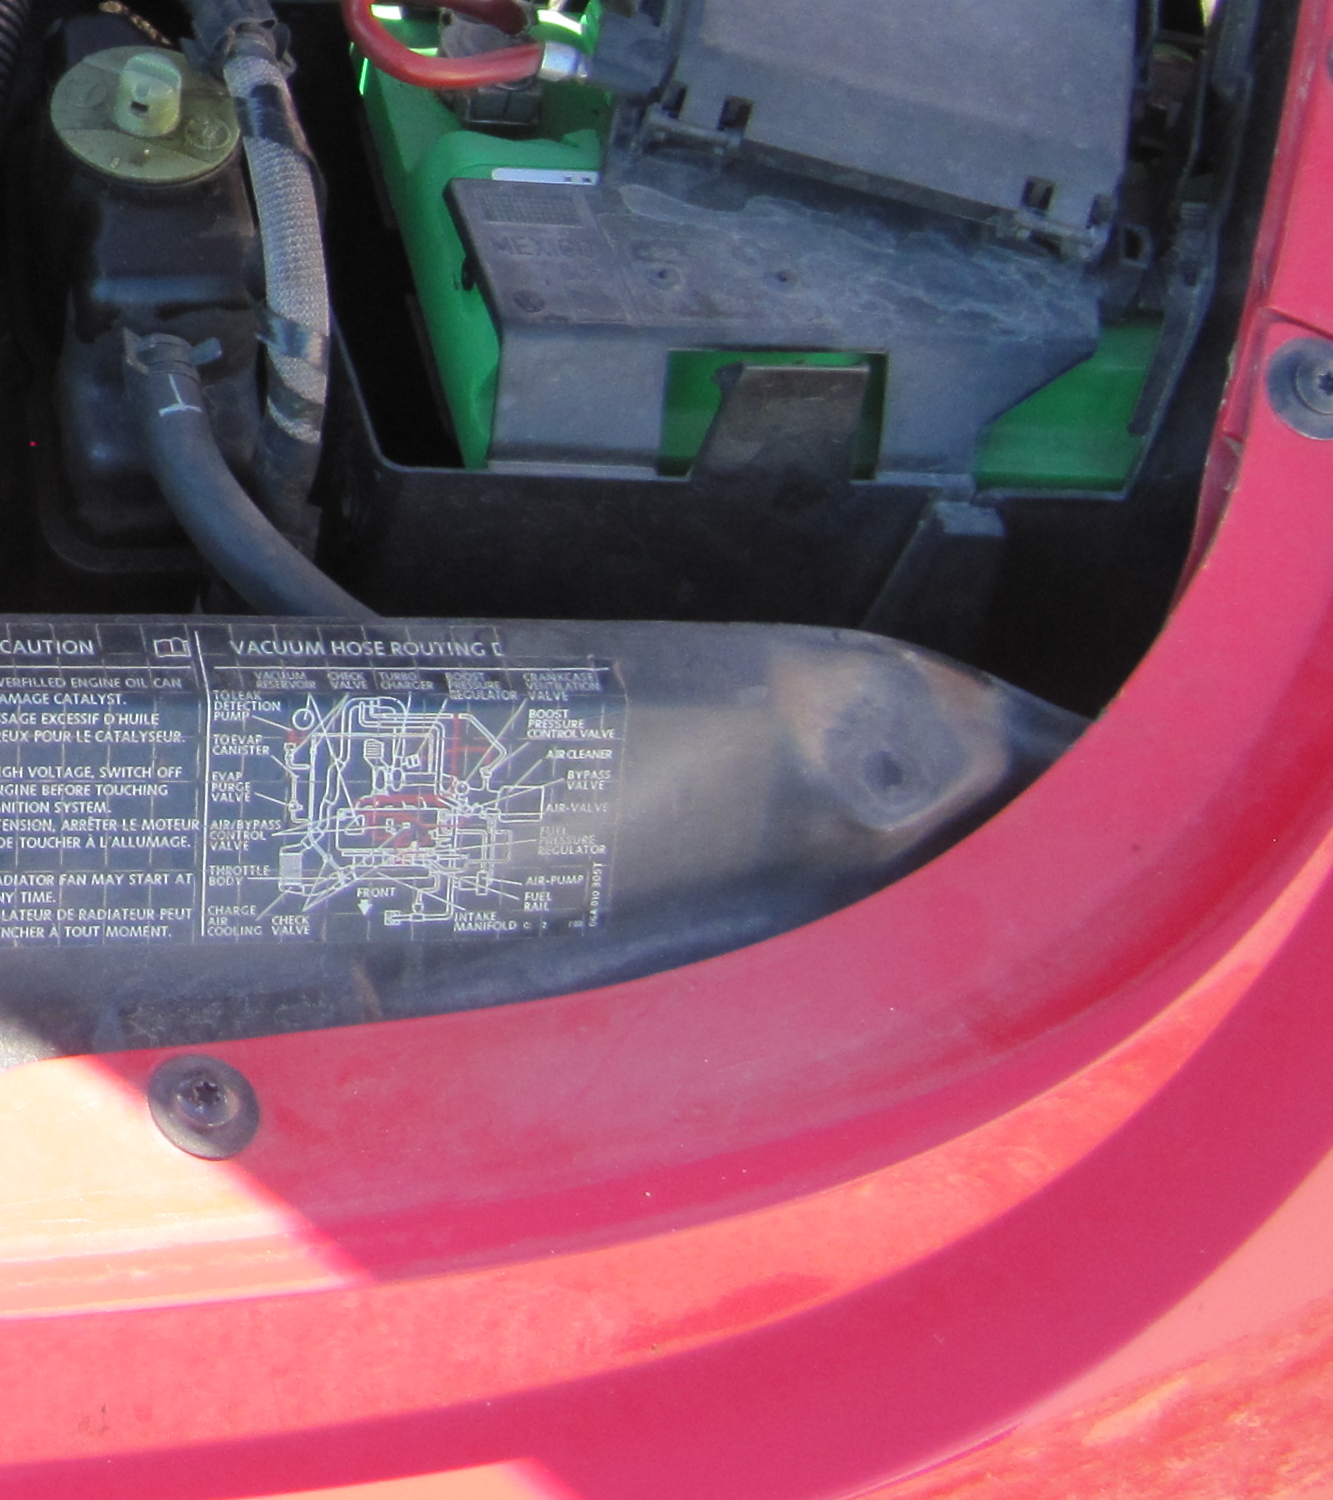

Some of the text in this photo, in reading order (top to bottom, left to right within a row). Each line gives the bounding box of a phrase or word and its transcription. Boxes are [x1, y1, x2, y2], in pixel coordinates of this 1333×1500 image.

[0, 639, 94, 655] CAUTION
[229, 640, 324, 656] VACUUM
[332, 641, 386, 656] HOSE
[391, 642, 485, 657] ROUTING
[70, 677, 121, 688] ENGINE
[125, 678, 147, 688] OIL
[153, 677, 182, 688] CAN
[53, 693, 126, 705] CATALYST.
[214, 690, 262, 701] TO LEAK
[214, 701, 281, 711] DETECTION
[41, 713, 99, 725] EXCESSIF
[104, 713, 159, 725] D'HUILE
[214, 711, 249, 721] PUMP
[529, 710, 569, 719] BOOST
[528, 720, 585, 729] PRESSURE
[34, 730, 71, 743] POUR
[76, 731, 91, 743] LE
[95, 730, 186, 743] CATALYSEUR.
[213, 734, 262, 744] TO EVAP
[527, 729, 616, 739] CONTROL VALVE
[212, 745, 269, 755] CANISTER
[567, 750, 613, 759] CLEANER
[99, 766, 151, 778] SWITCH
[157, 766, 182, 778] OFF
[212, 771, 242, 781] EVAP
[567, 770, 611, 779] BYPASS
[42, 784, 90, 796] BEFORE
[96, 784, 168, 796] TOUCHING
[211, 782, 250, 792] PURGE
[567, 781, 605, 790] VALVE
[211, 793, 250, 802] VALVE
[54, 802, 111, 813] SYSTEM.
[60, 816, 117, 832] ARRÊTER
[122, 819, 137, 831] LE
[141, 819, 200, 832] MOTEUR
[19, 837, 80, 849] TOUCHER
[85, 833, 96, 848] À
[100, 837, 191, 848] L'ALLUMAGE.
[59, 874, 86, 886] FAN
[91, 873, 124, 885] MAY
[129, 873, 170, 885] START
[175, 873, 193, 885] AT
[526, 876, 584, 885] AIR-PUMP
[21, 891, 56, 903] TIME.
[357, 887, 395, 897] FRONT
[524, 893, 552, 901] FUEL
[524, 902, 549, 911] RAIL
[57, 909, 73, 921] DE
[78, 909, 154, 921] RADIATEUR
[160, 908, 192, 920] PEUT
[454, 912, 497, 921] INTAKE
[454, 921, 517, 931] MANIFOLD
[63, 926, 100, 938] TOUT
[105, 926, 171, 938] MOMENT.
